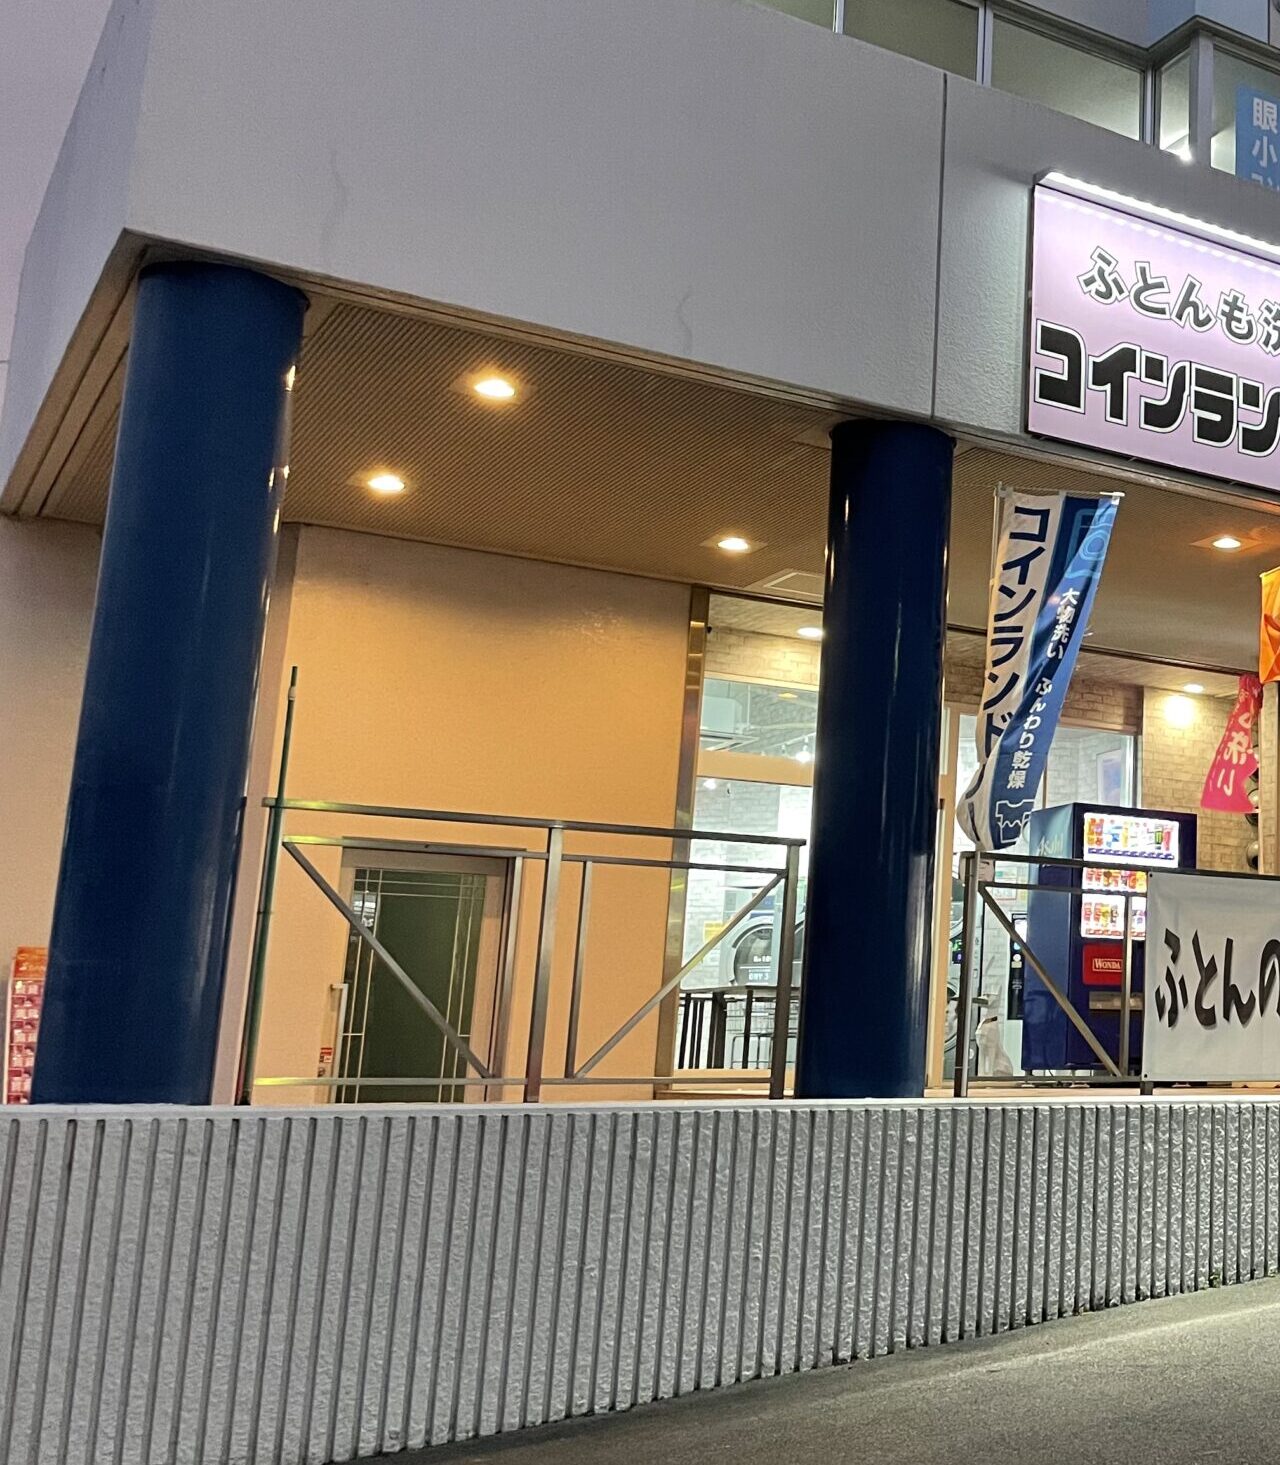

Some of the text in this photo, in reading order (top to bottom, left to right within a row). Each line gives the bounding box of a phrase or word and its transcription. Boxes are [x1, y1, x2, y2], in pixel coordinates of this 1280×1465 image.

[1007, 588, 1080, 789] 大物洗い ふんわり乾燥
